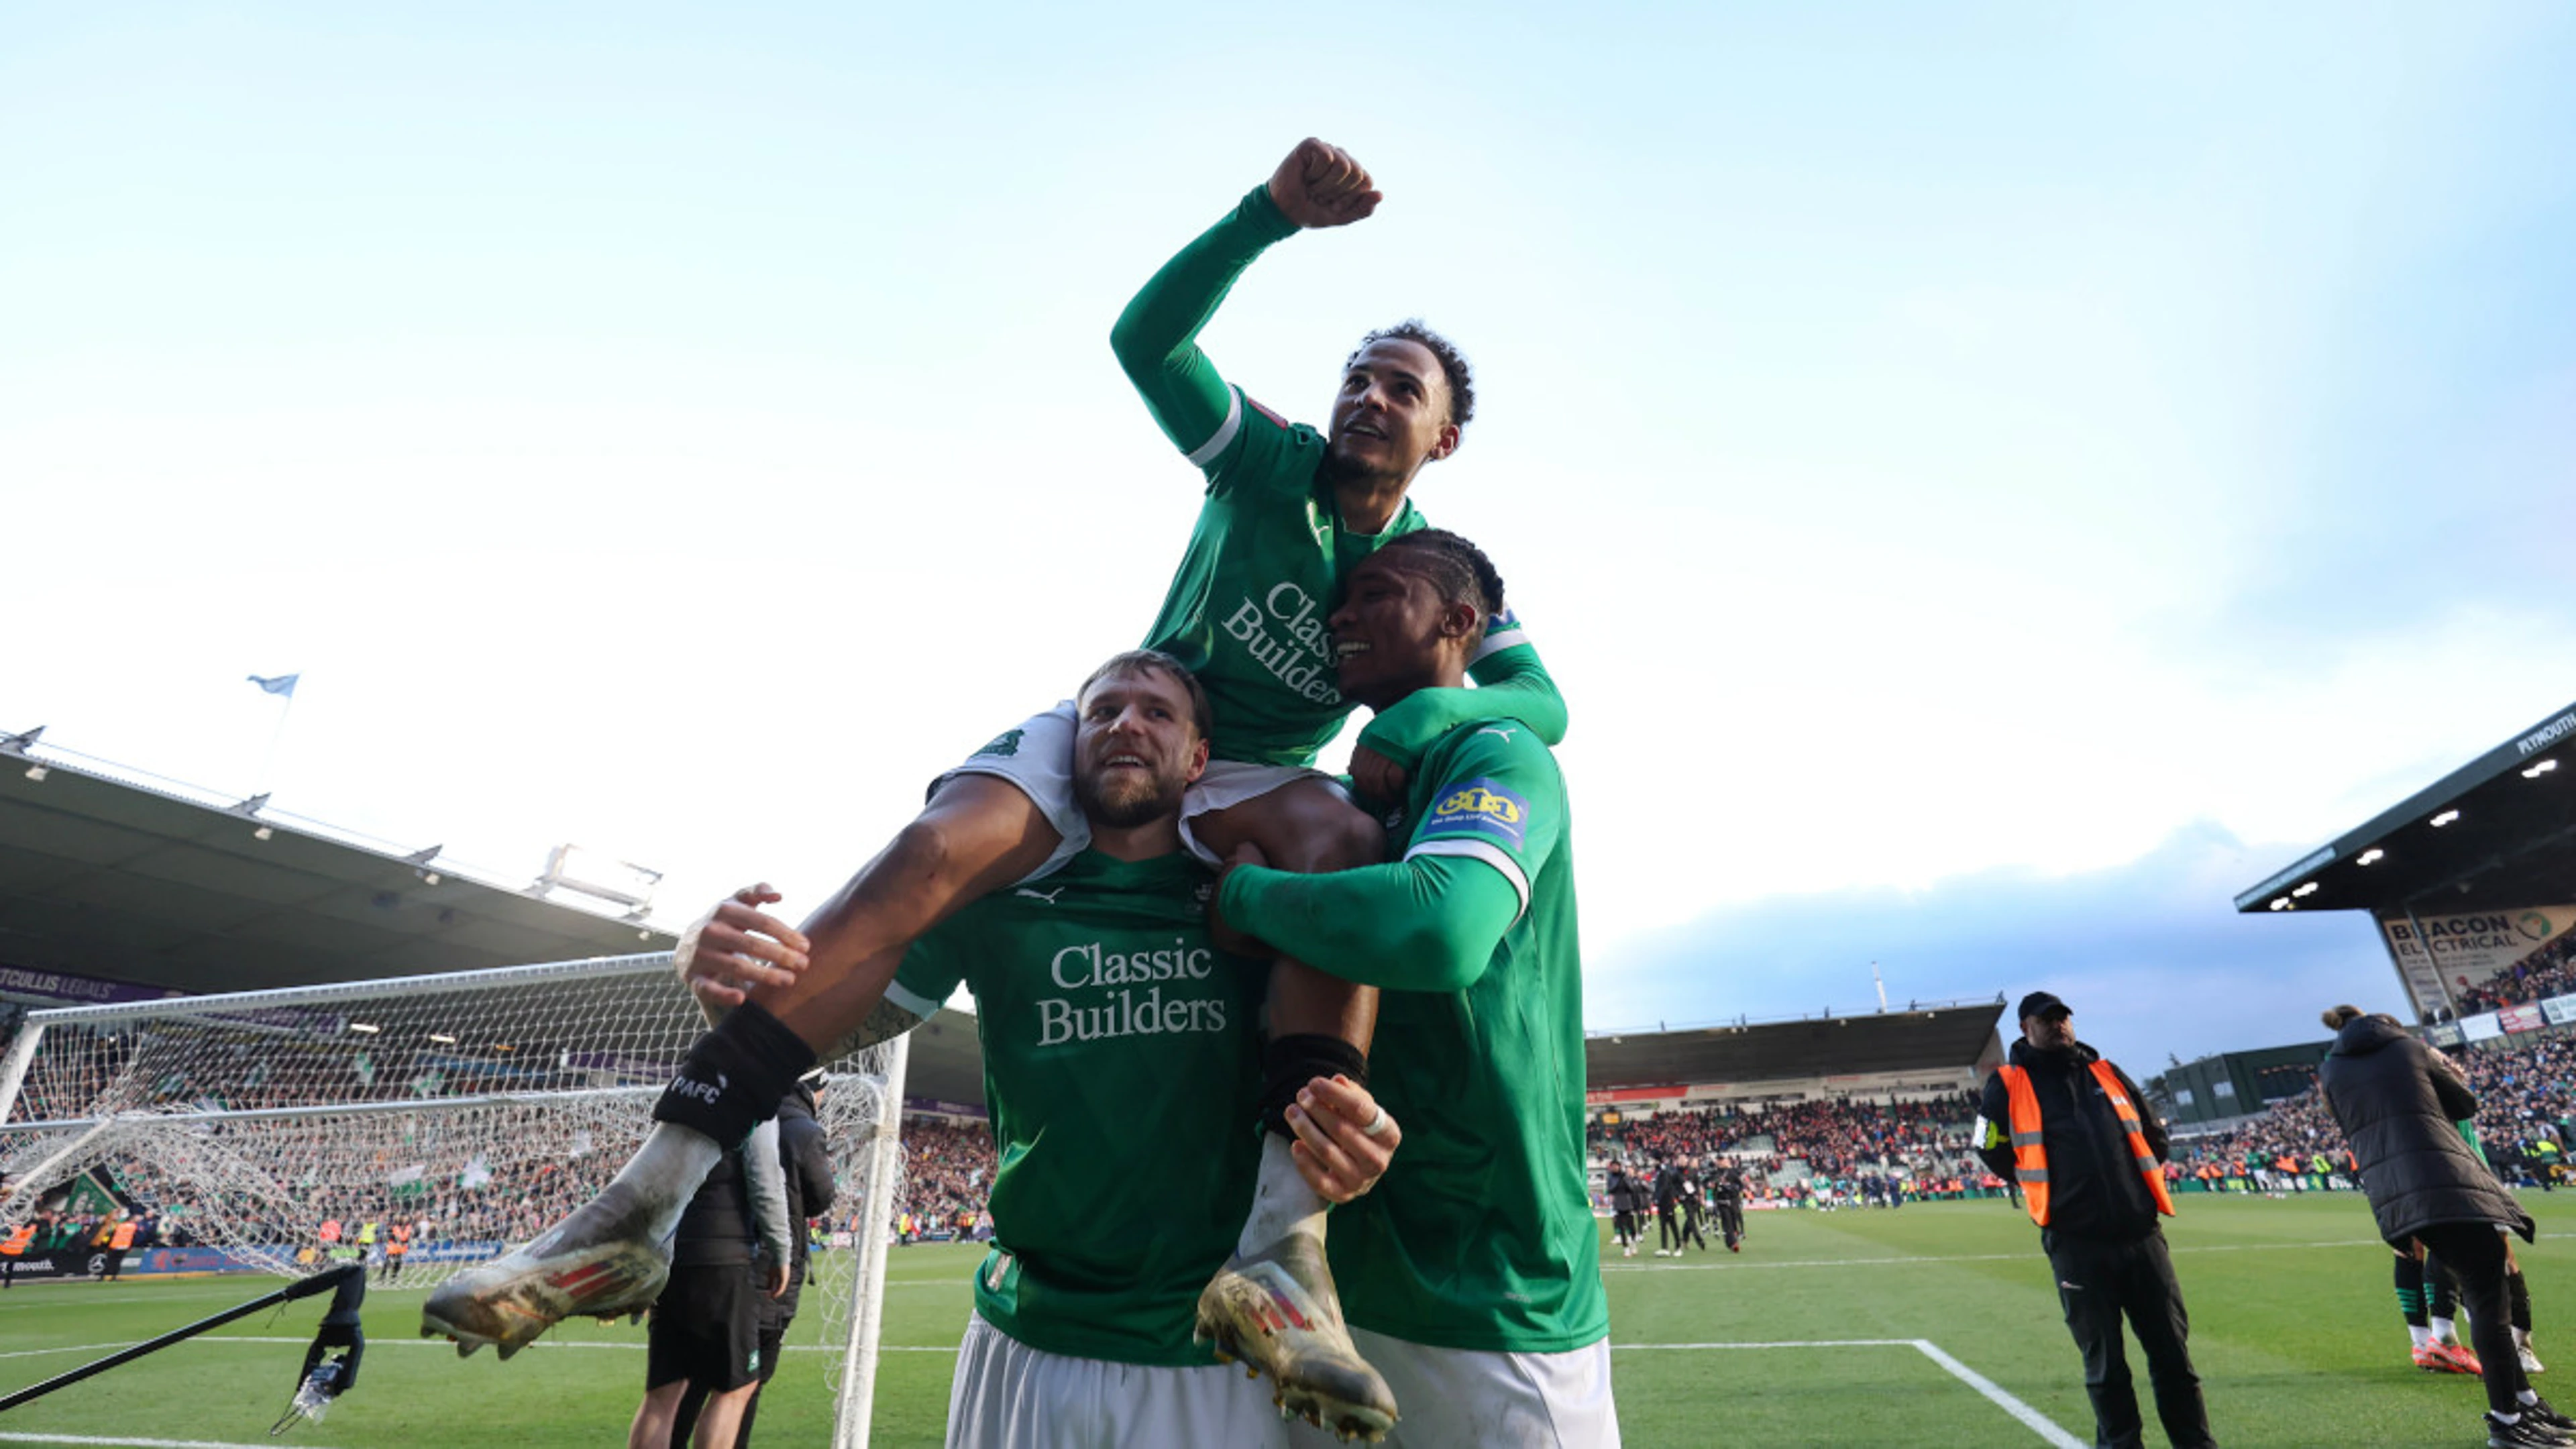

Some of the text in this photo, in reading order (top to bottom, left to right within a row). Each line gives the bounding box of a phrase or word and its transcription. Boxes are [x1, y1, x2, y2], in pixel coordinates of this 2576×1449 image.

[1051, 938, 1212, 989] Classic
[2399, 934, 2518, 956] ELCTRICAL
[1036, 986, 1226, 1046] Builders
[672, 1075, 721, 1104] PAFC
